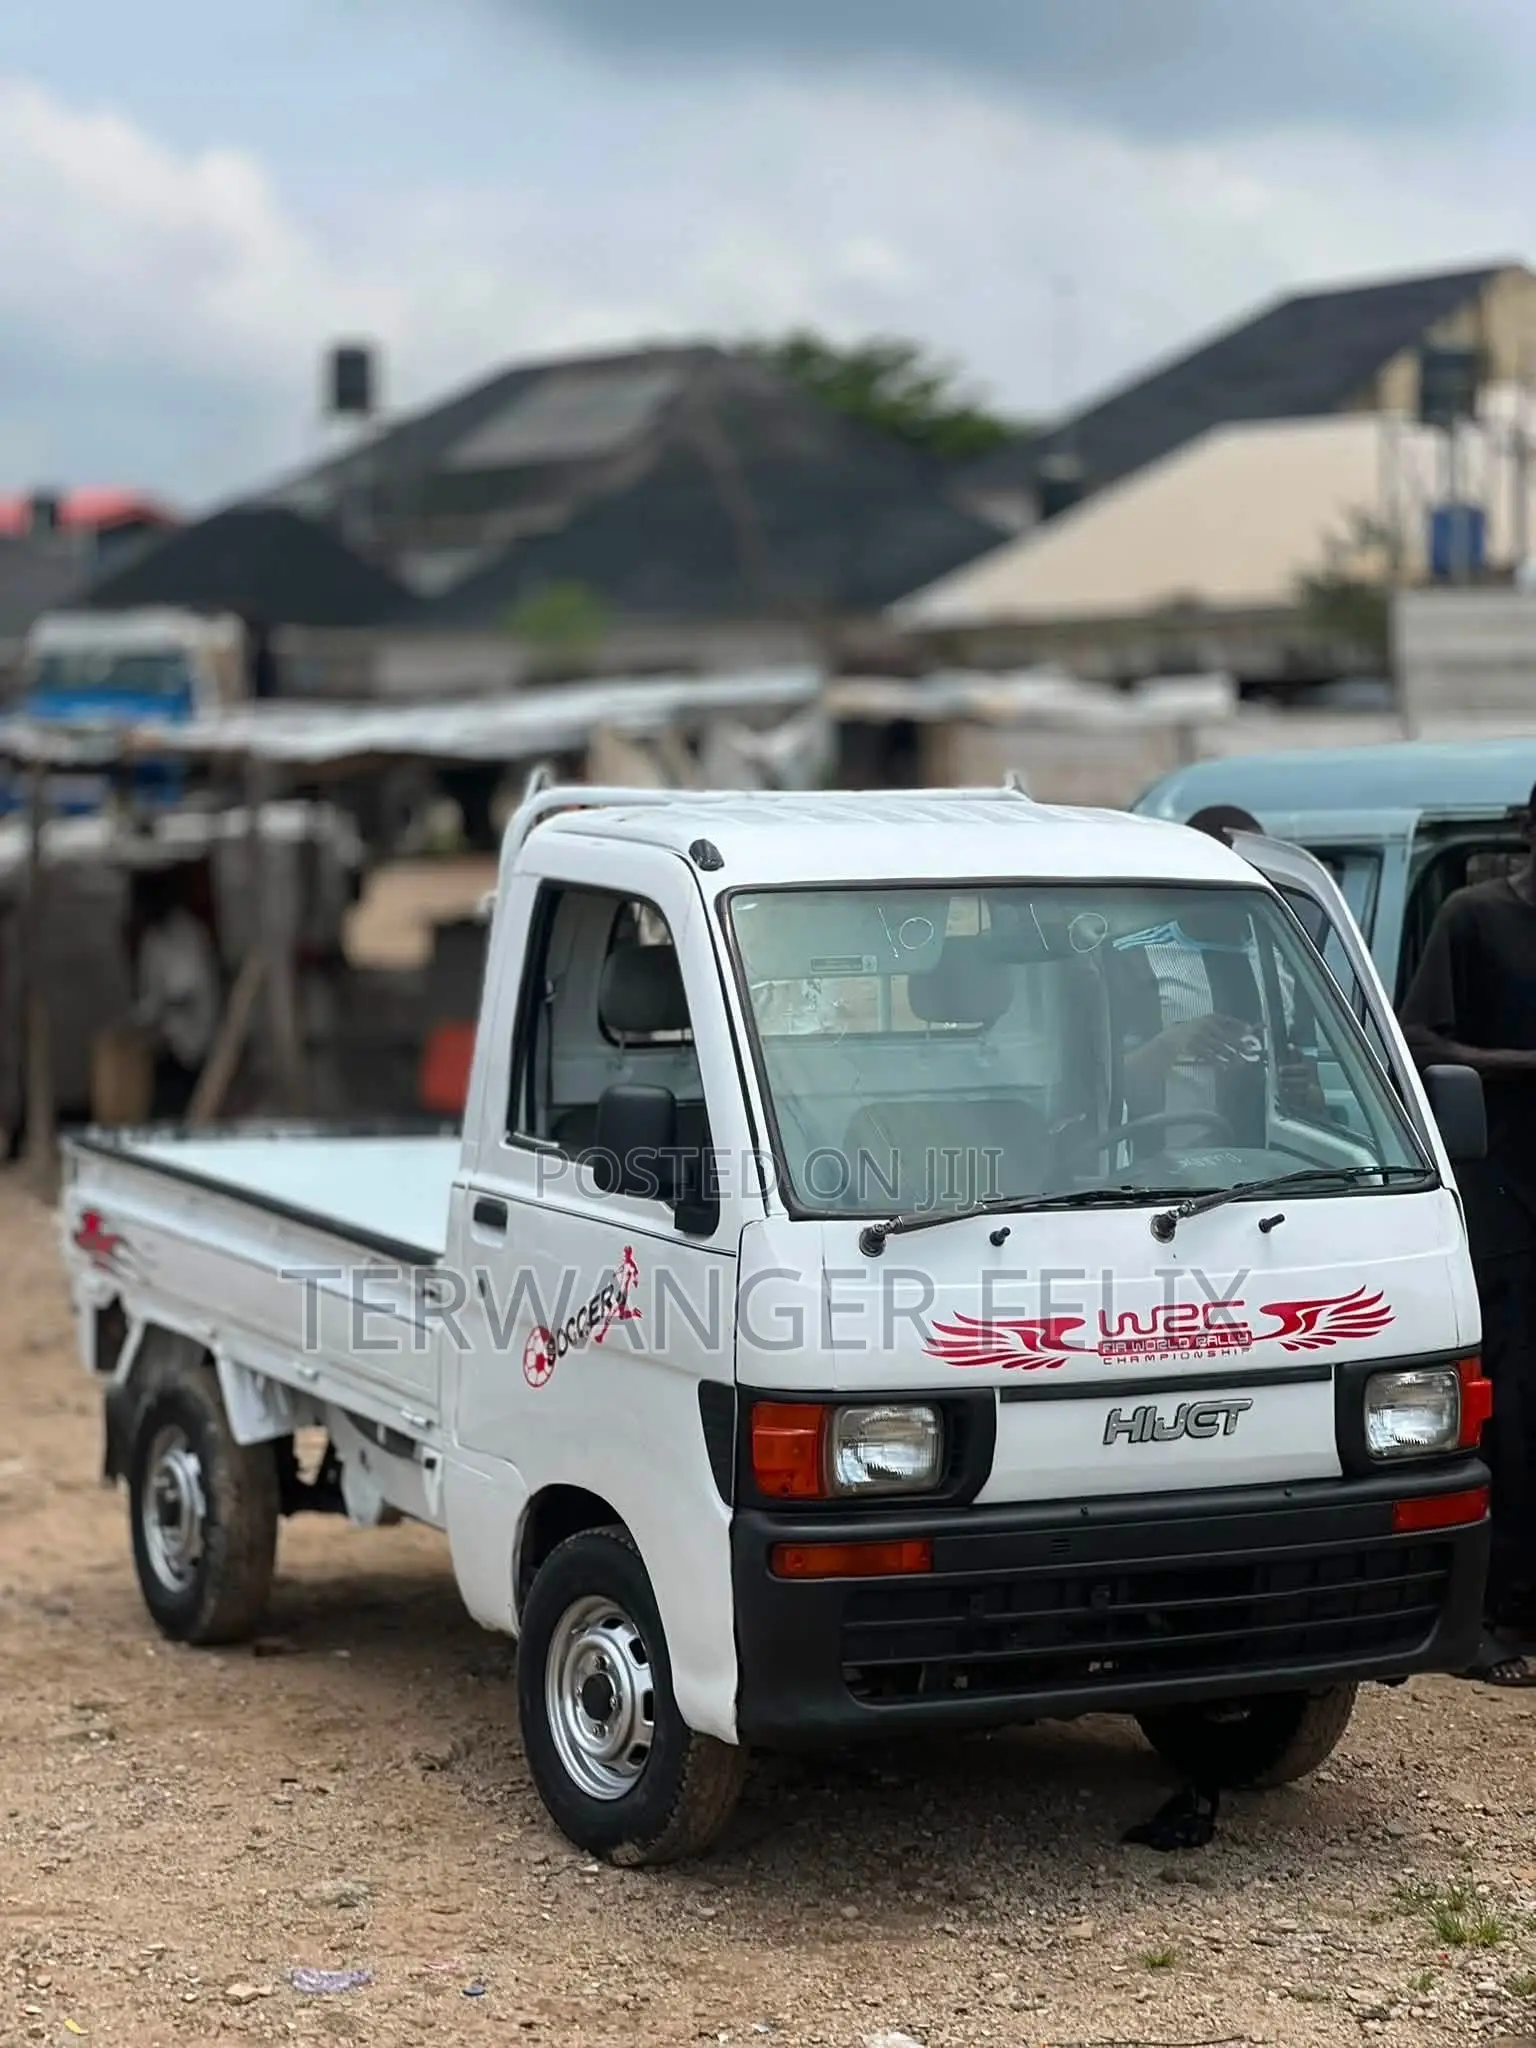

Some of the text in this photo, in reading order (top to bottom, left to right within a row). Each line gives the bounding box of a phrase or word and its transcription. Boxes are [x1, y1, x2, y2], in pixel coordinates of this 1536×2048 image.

[1131, 1337, 1190, 1352] WORLD
[1195, 1331, 1250, 1348] RALLY
[1102, 1347, 1251, 1366] CHAMPIONSHIP
[1103, 1398, 1254, 1445] HIJET
